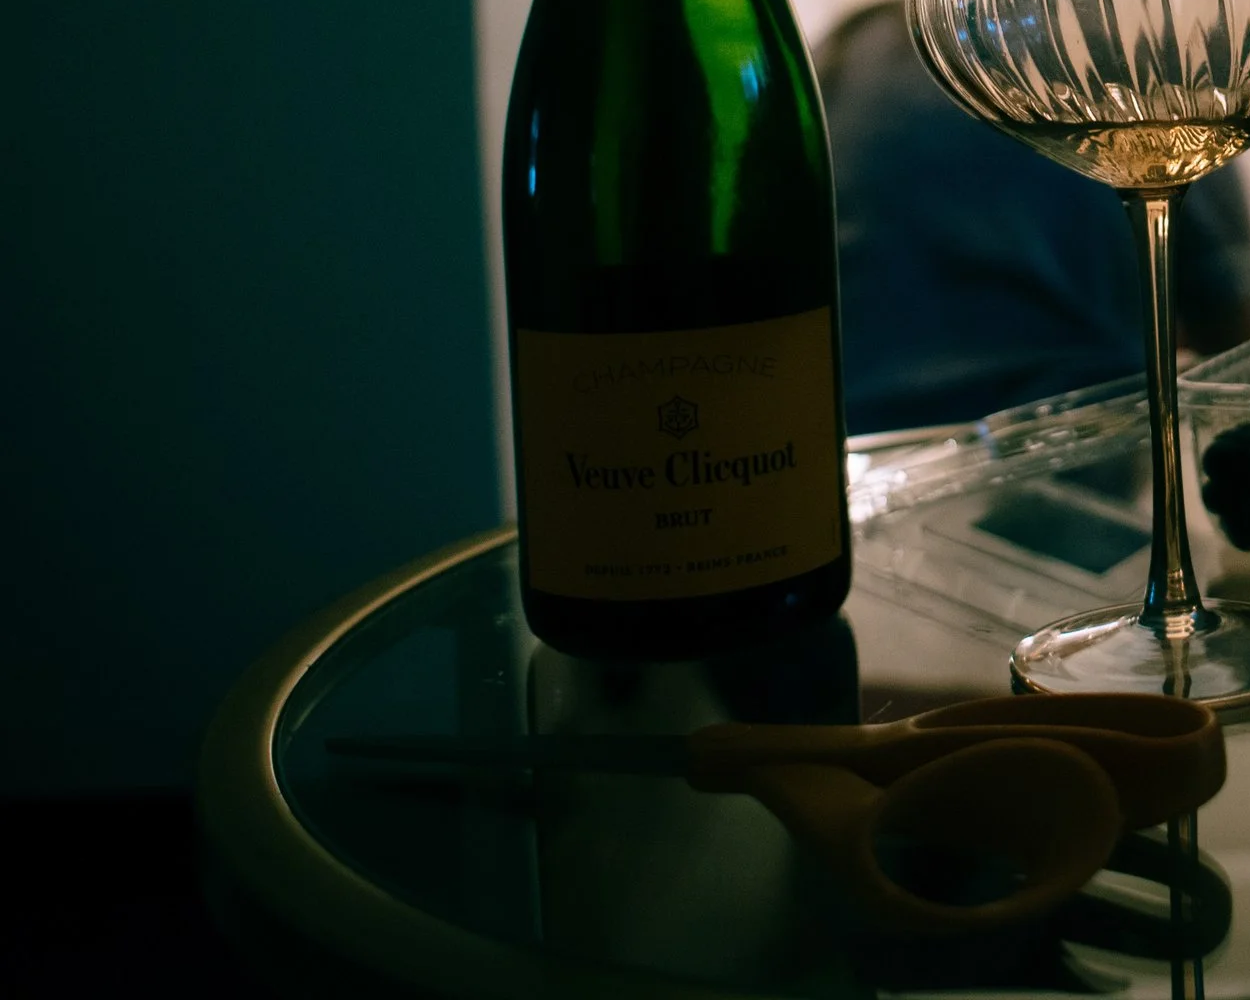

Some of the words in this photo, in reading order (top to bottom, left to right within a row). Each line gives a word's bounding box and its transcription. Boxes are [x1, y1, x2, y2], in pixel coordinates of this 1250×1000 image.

[572, 353, 778, 395] CHAMPAGNE
[566, 450, 656, 490] Veuve
[664, 441, 798, 488] Clicquot
[654, 508, 713, 531] BRUT
